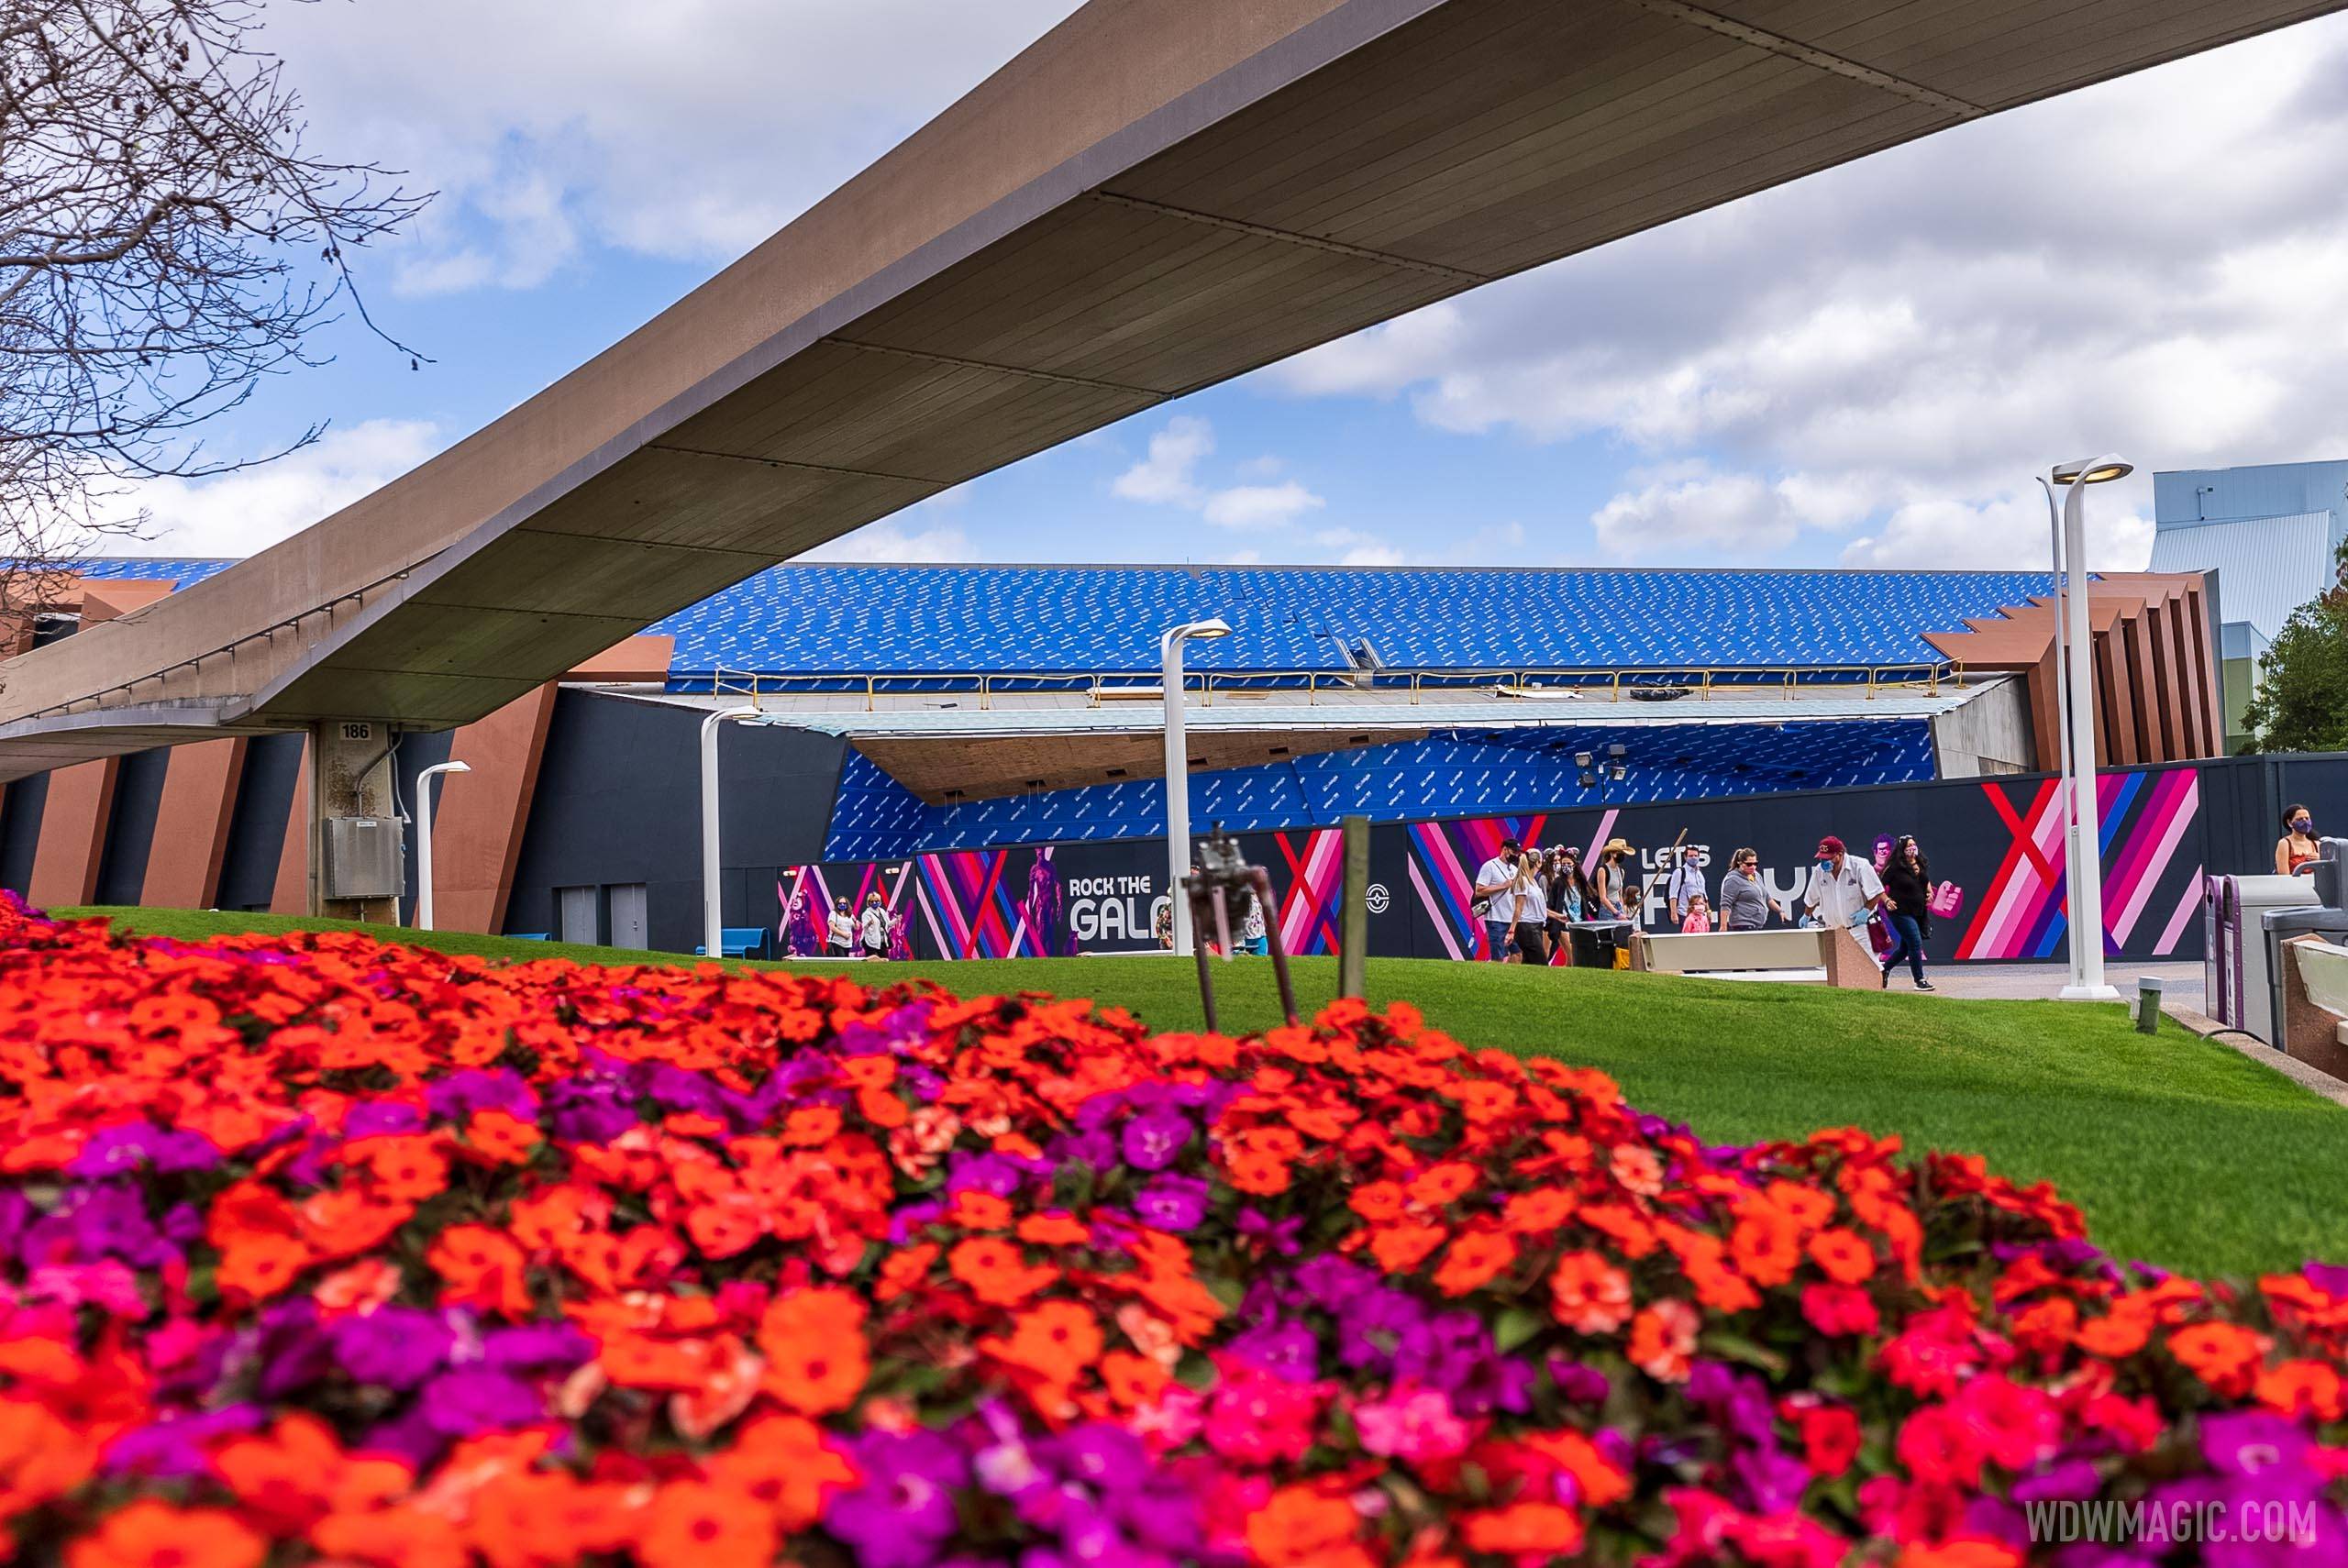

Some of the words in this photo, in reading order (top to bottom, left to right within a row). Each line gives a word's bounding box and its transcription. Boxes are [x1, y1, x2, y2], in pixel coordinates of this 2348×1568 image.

[342, 723, 369, 739] 186
[1069, 877, 1114, 897] ROCK
[1117, 875, 1151, 895] THE
